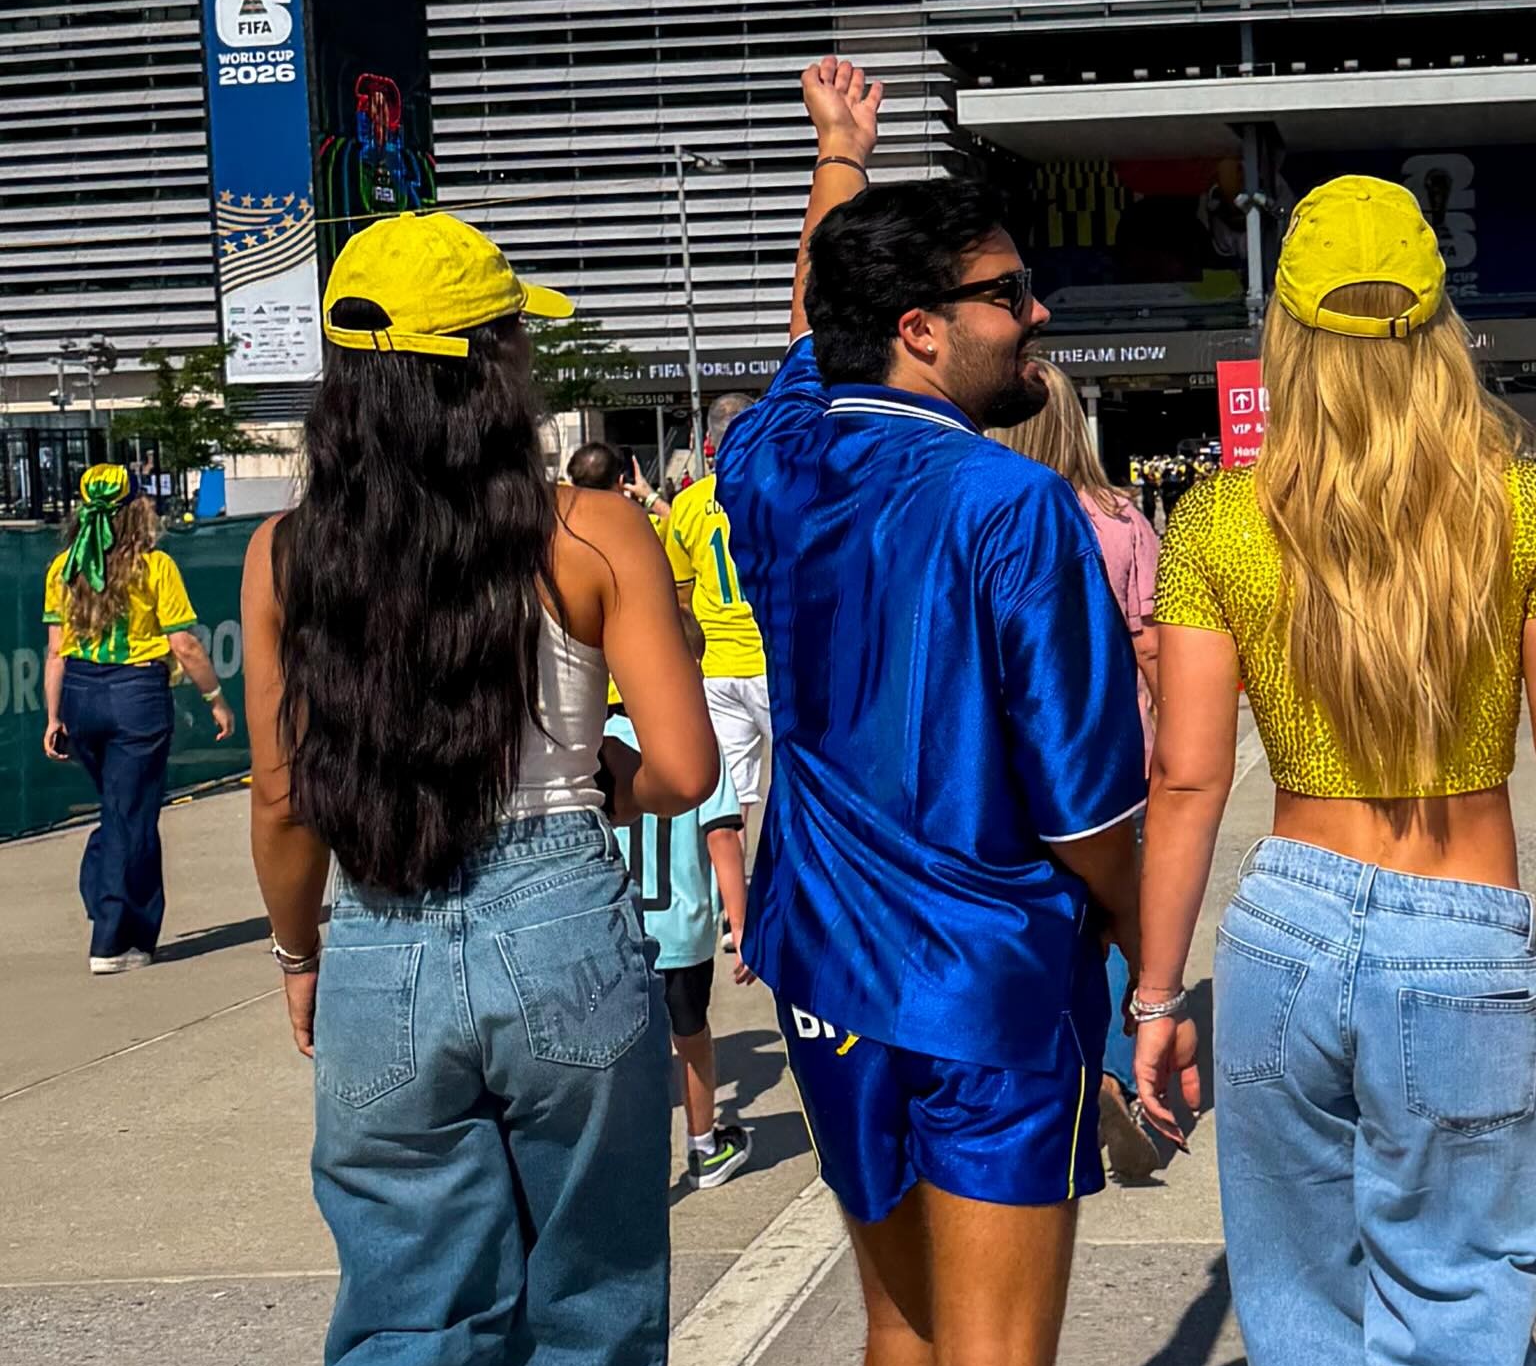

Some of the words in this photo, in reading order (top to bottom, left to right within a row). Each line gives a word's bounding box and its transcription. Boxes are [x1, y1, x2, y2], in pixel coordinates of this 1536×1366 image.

[238, 20, 272, 35] FIFA
[218, 51, 266, 65] WORLD
[267, 50, 295, 63] CUP
[219, 64, 296, 85] 2026
[1120, 346, 1167, 361] NOW
[649, 363, 684, 380] FIFA
[1232, 423, 1252, 434] VIP
